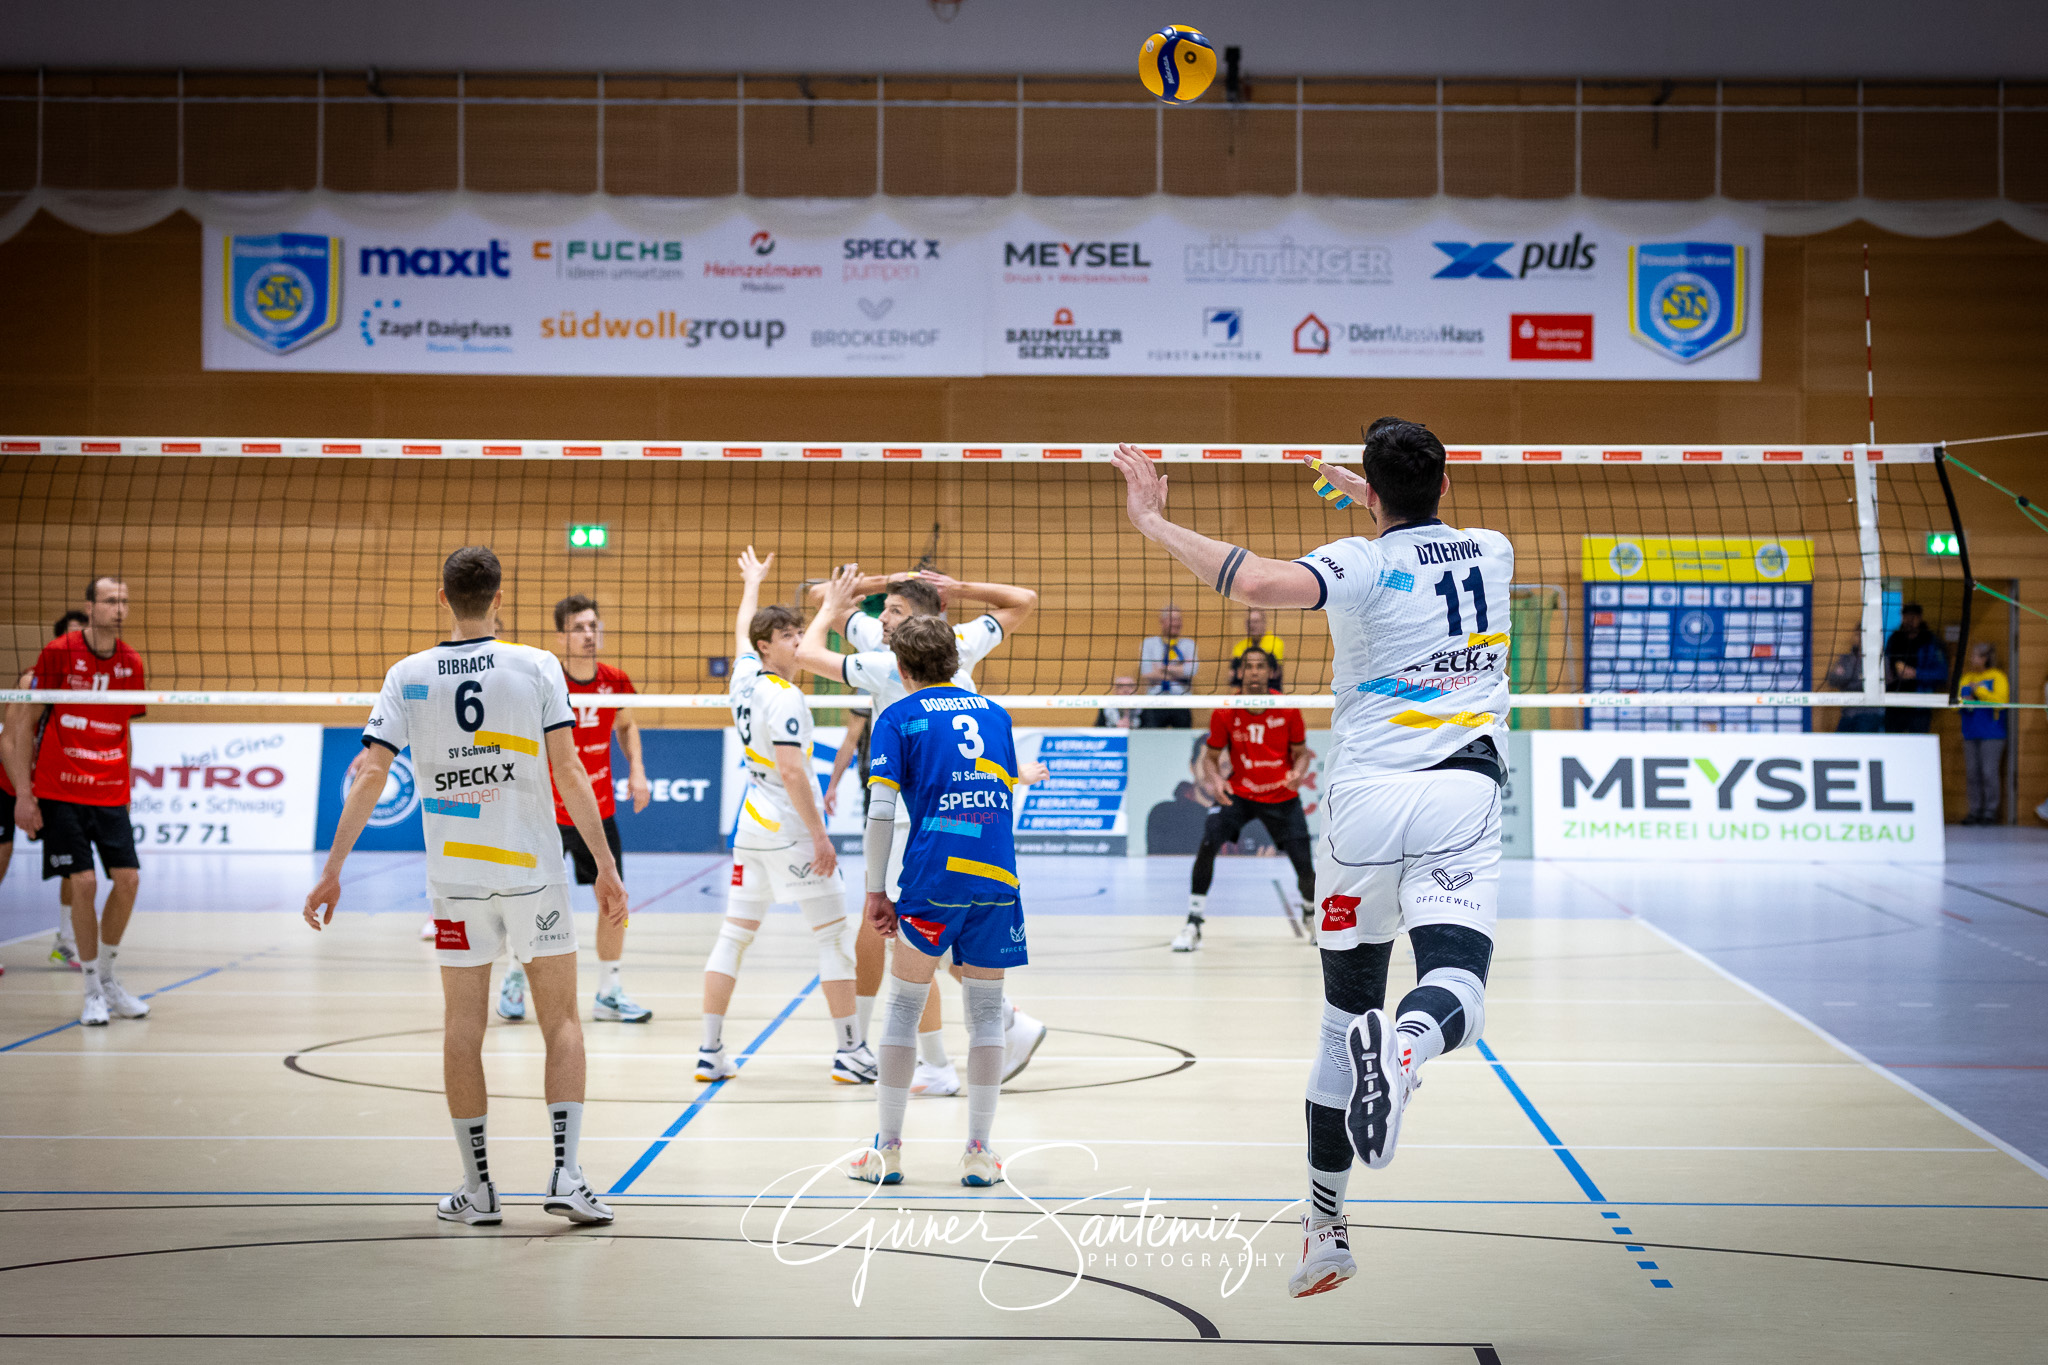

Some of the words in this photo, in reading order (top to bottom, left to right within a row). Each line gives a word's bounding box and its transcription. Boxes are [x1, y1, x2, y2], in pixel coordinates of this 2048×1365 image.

[360, 240, 510, 278] maxit
[567, 241, 682, 260] FUCHS
[843, 239, 916, 259] SPECK
[1004, 242, 1151, 267] MEYSEL
[1519, 233, 1597, 279] puls
[379, 320, 423, 340] Zapf
[1018, 345, 1110, 359] SERVICES
[1414, 539, 1483, 565] DZIERWA
[1320, 556, 1345, 580] puls
[1434, 566, 1489, 637] 11
[438, 654, 495, 675] BIBRACK
[455, 680, 485, 733] 6
[920, 697, 989, 712] DOBBERTIN
[1235, 698, 1276, 706] FUCHS
[1590, 697, 1631, 705] FUCHS
[1768, 696, 1809, 704] FUCHS
[951, 714, 985, 760] 3
[1248, 724, 1266, 745] 17
[224, 734, 285, 759] Gino
[448, 747, 460, 759] SV
[462, 742, 501, 757] Schwaig
[871, 754, 888, 770] puls
[130, 766, 285, 789] NTRO
[434, 765, 499, 792] SPECK
[952, 771, 963, 782] SV
[964, 769, 998, 783] Schwaig
[1561, 757, 1914, 812] MEYSEL
[206, 796, 285, 817] Schwaig
[437, 787, 501, 814] pumpen
[939, 790, 997, 811] SPECK
[940, 811, 999, 831] pumpen
[156, 824, 189, 844] 57
[201, 824, 230, 844] 71
[1562, 821, 1698, 840] ZIMMEREI
[1708, 822, 1771, 841] UND
[1780, 823, 1916, 843] HOLZBAU
[1416, 896, 1482, 912] OFFICEWELT
[1318, 1231, 1346, 1243] DAME
